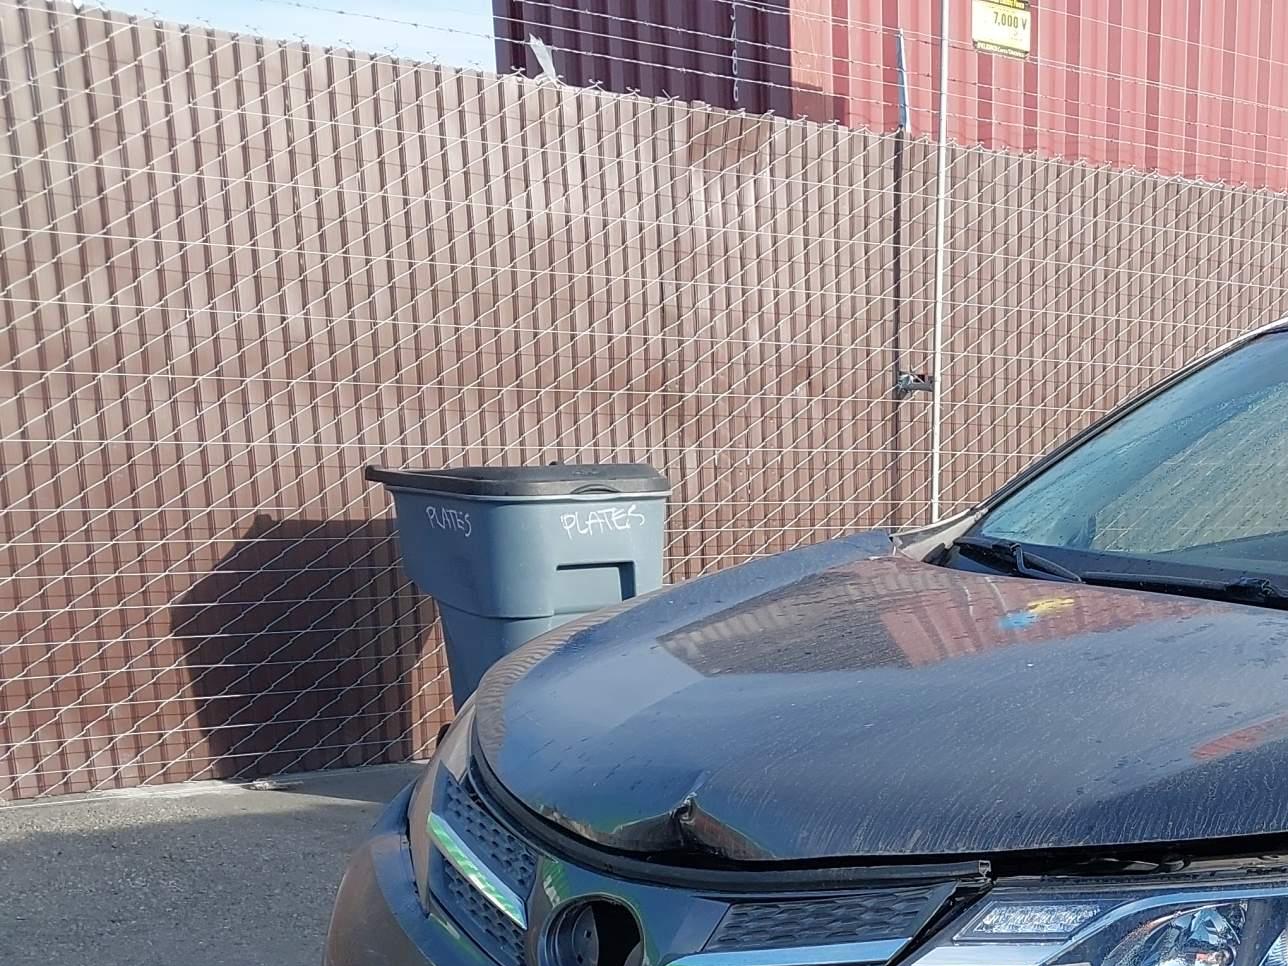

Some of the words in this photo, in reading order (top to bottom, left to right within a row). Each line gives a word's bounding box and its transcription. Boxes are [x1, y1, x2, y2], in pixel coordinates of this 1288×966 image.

[1021, 17, 1028, 31] V
[425, 505, 473, 538] PLATES
[561, 503, 646, 540] PLATES
